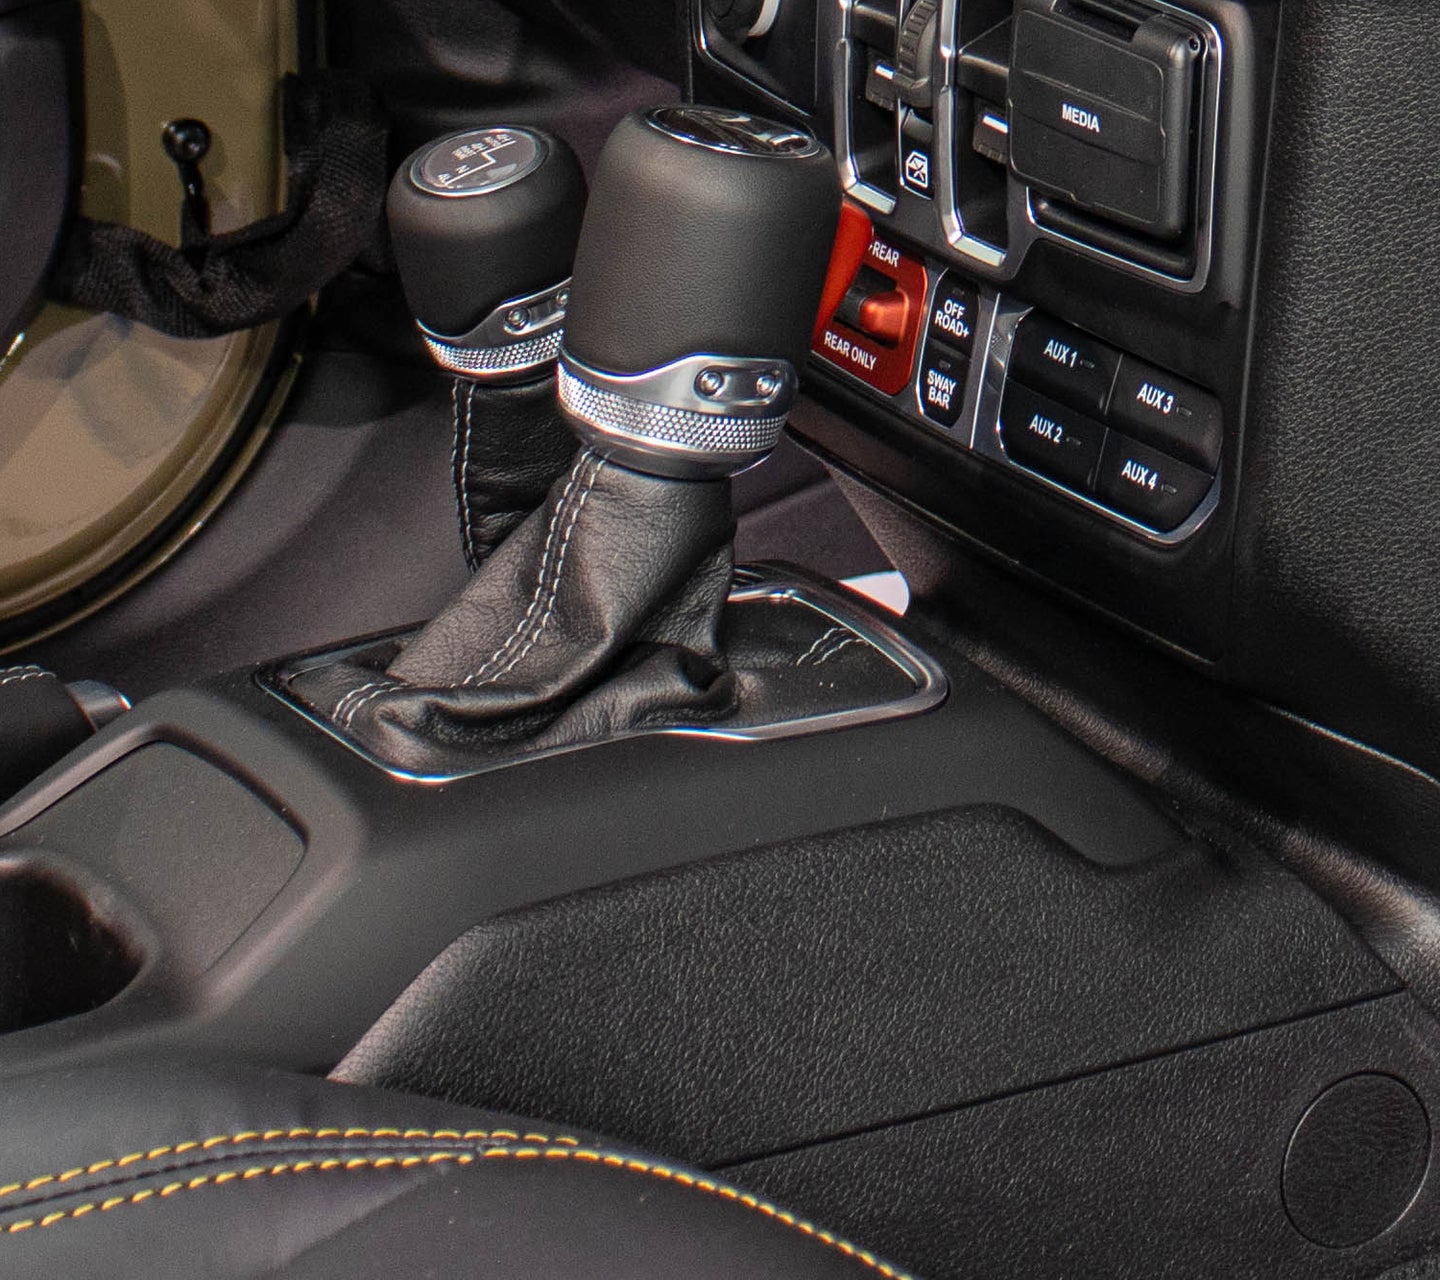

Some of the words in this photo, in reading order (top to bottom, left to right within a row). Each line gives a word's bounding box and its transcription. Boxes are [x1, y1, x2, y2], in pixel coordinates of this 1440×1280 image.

[1062, 103, 1100, 132] MEDIA
[944, 299, 966, 317] OFF
[935, 310, 970, 338] ROAD+
[824, 331, 850, 356] REAR
[851, 346, 877, 370] ONLY
[1043, 339, 1070, 364] AUX
[1069, 351, 1078, 368] 1
[927, 370, 957, 395] SWAY
[928, 388, 951, 410] BAR
[1136, 383, 1165, 410] AUX
[1163, 395, 1174, 413] 3
[1029, 414, 1057, 439] AUX
[1054, 426, 1063, 443] 2
[1121, 460, 1149, 487] AUX
[1148, 472, 1158, 490] 4
